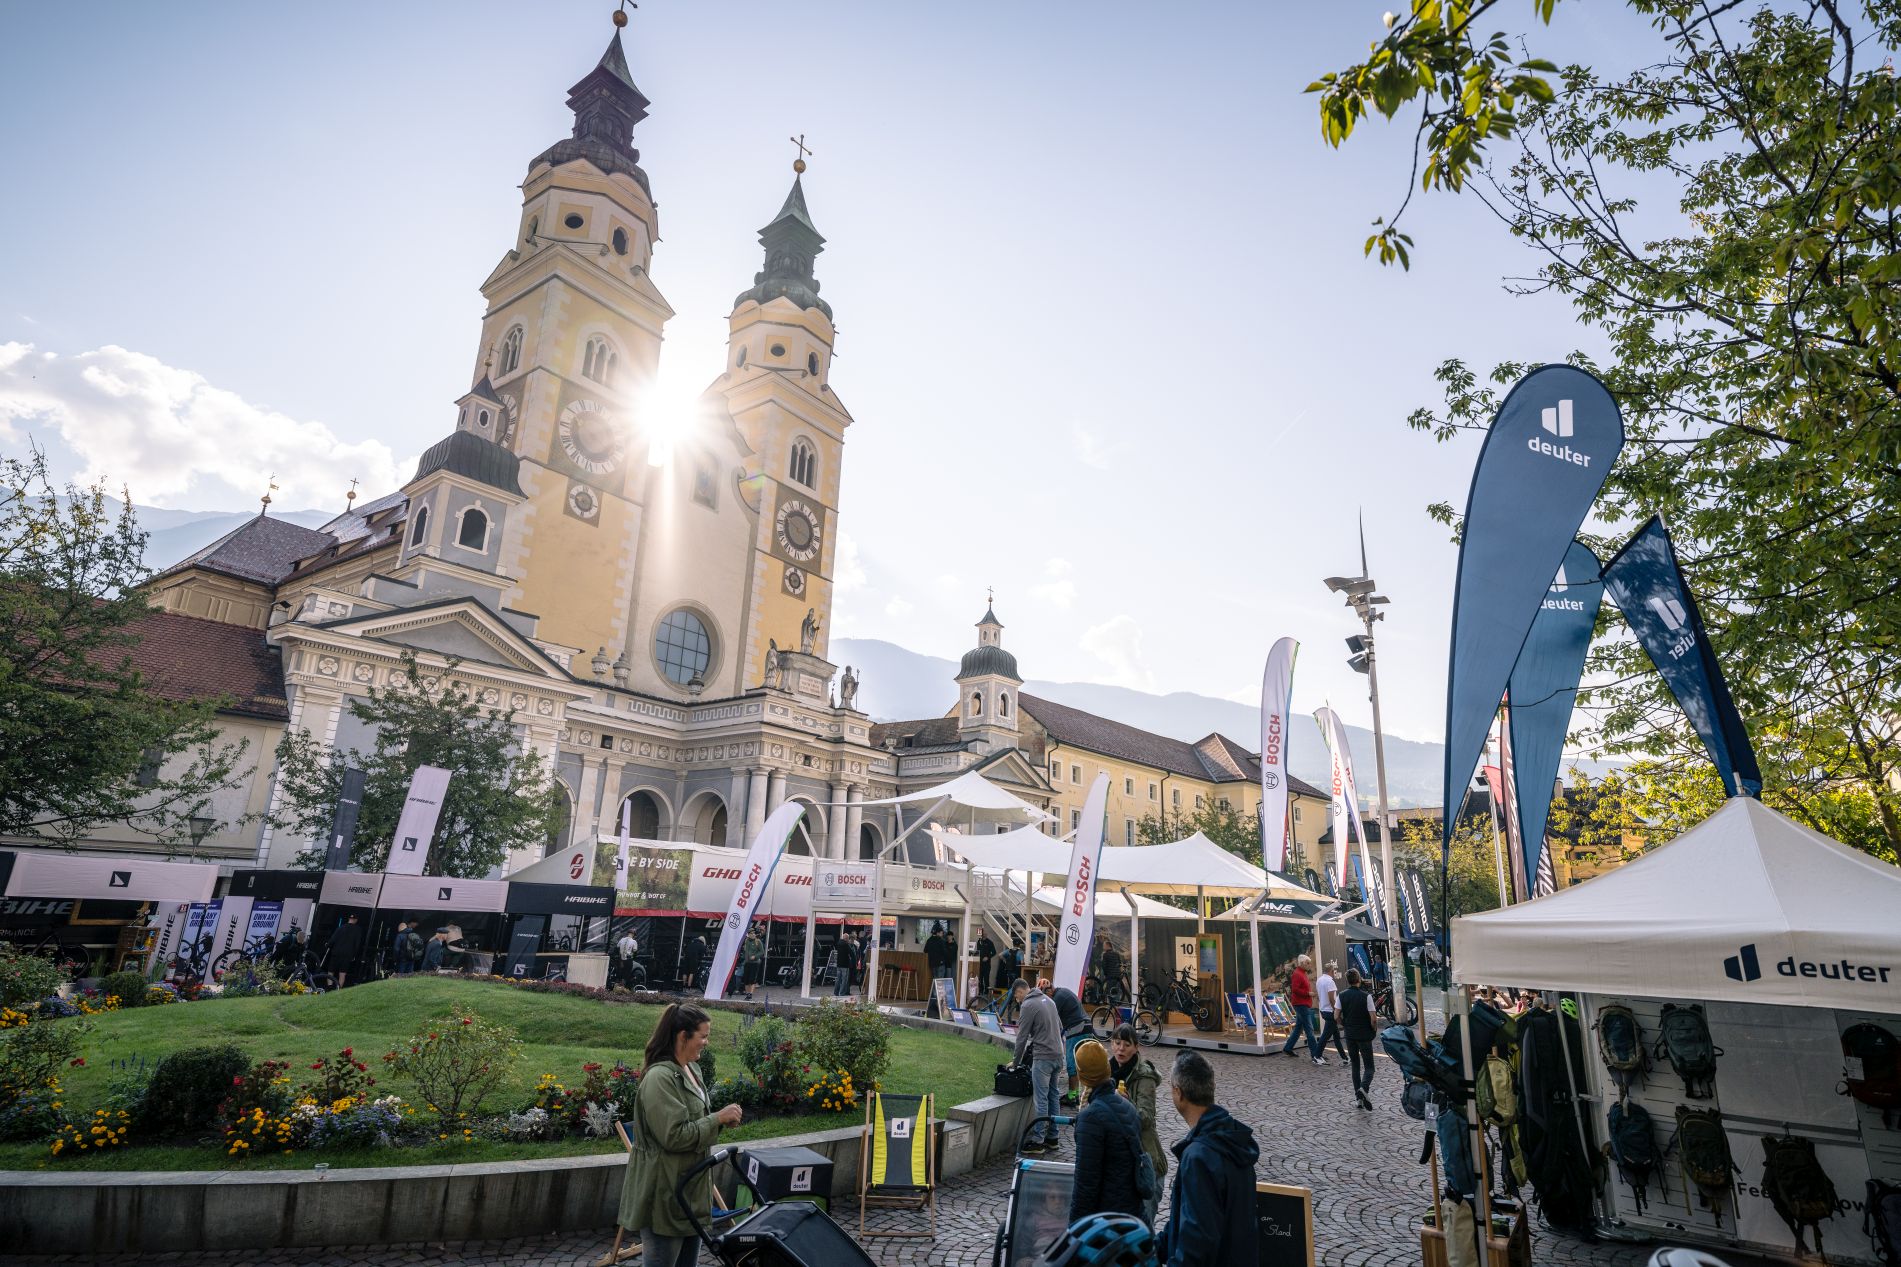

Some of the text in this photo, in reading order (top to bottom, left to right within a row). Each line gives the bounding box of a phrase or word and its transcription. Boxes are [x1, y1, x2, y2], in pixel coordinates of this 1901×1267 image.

[1528, 436, 1591, 467] deuter
[1266, 714, 1281, 765] BOSCH
[1332, 752, 1342, 797] BOS
[611, 855, 680, 870] SDE BY SIDE
[702, 867, 742, 880] GHO
[837, 875, 866, 885] BOSCH
[736, 863, 762, 909] BOSCH
[922, 879, 945, 891] BOSCH
[1072, 855, 1091, 917] BOSCH
[0, 900, 74, 914] BIKE
[564, 895, 608, 904] HAIBIKE
[266, 913, 279, 921] ANY
[158, 913, 175, 962] AIBIKE
[1776, 956, 1891, 983] deuter
[1736, 1182, 1771, 1199] Fee
[1264, 1223, 1292, 1237] Stand
[739, 1235, 757, 1243] THULE
